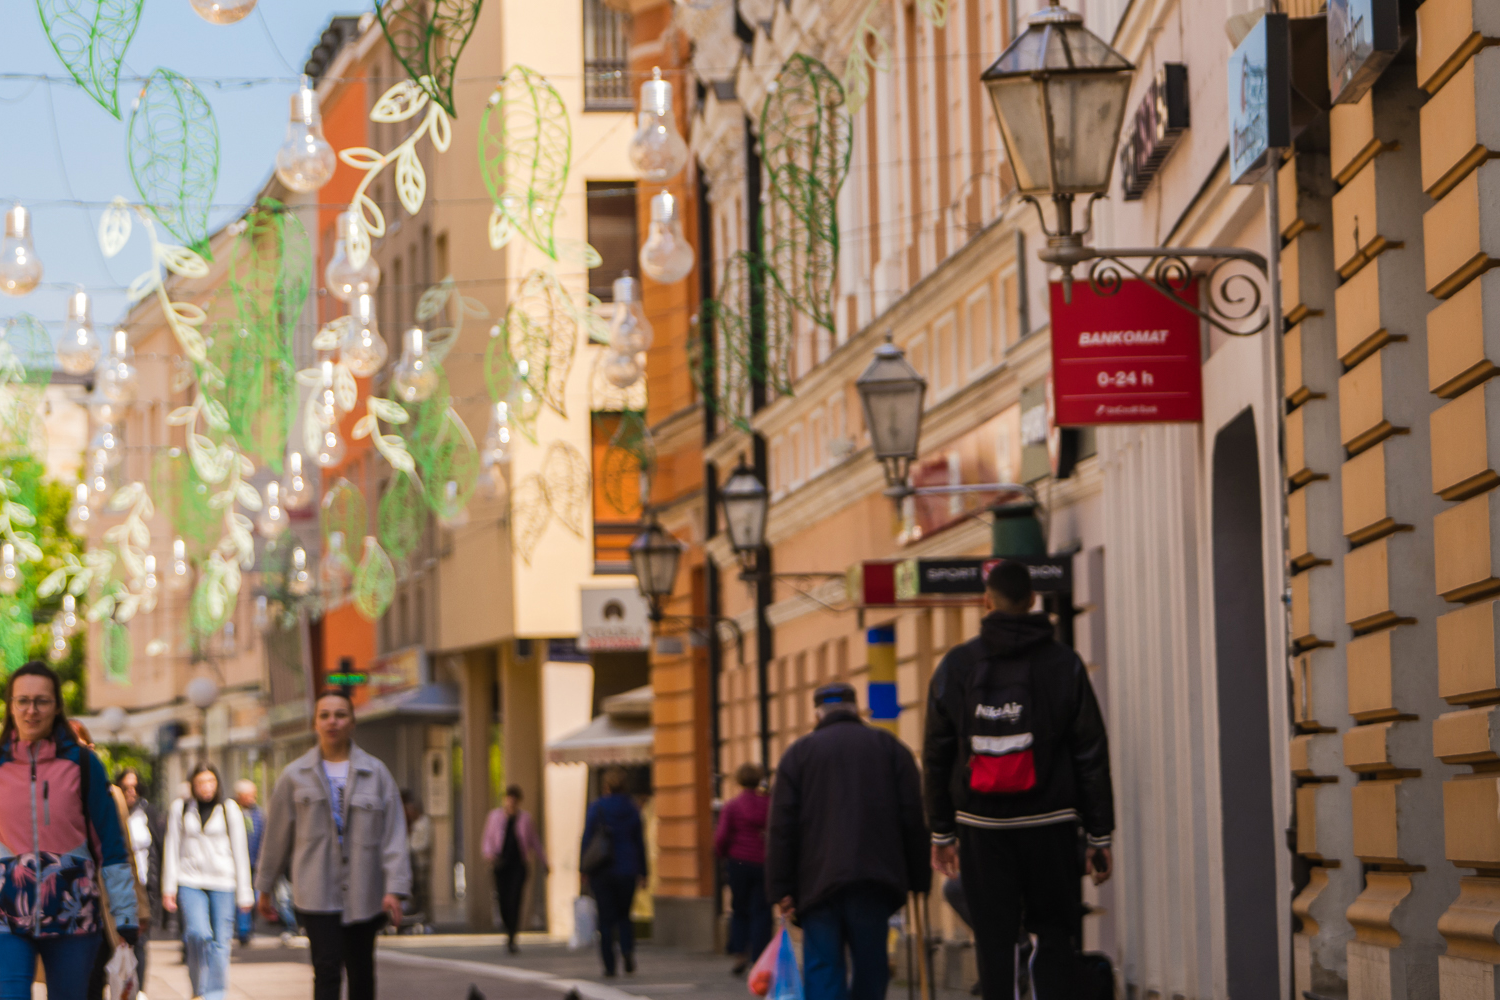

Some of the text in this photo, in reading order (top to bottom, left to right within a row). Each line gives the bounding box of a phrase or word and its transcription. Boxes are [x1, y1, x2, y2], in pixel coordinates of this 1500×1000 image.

[1079, 329, 1169, 347] BANKOMAT
[1097, 370, 1154, 388] 0-24 h
[927, 564, 1064, 582] SPORT SION
